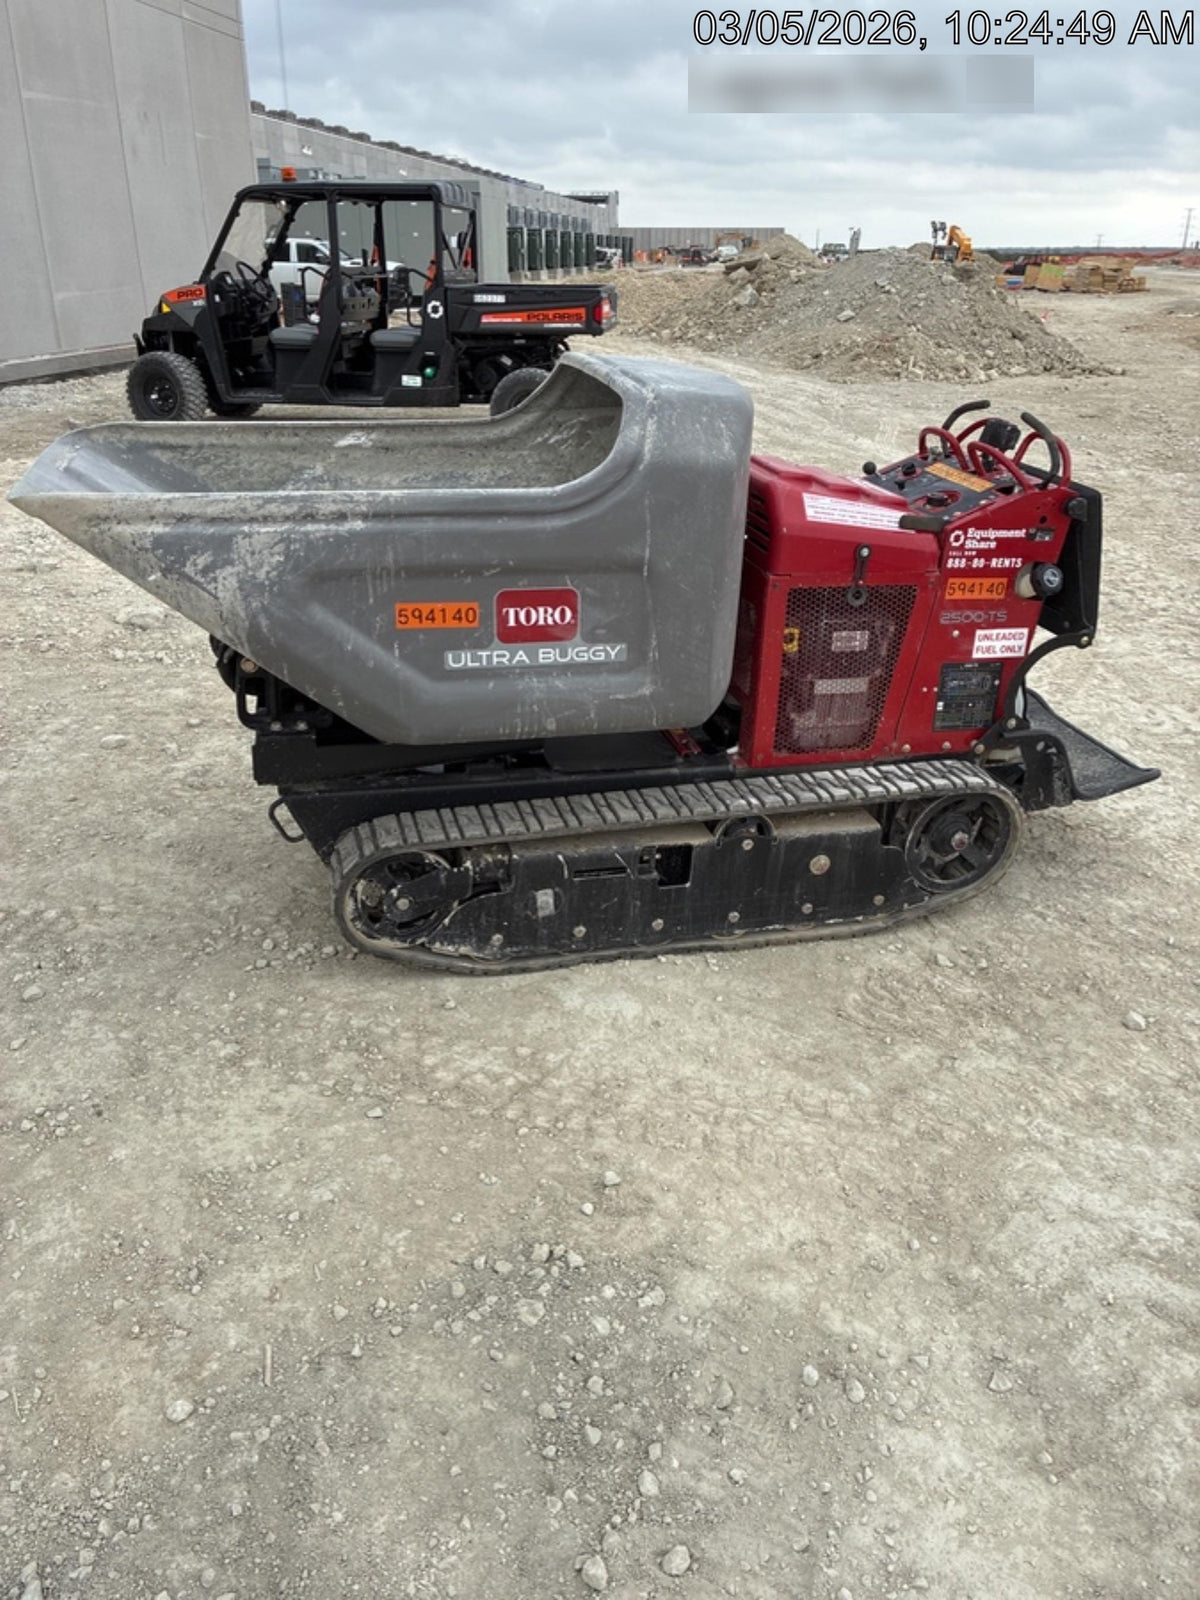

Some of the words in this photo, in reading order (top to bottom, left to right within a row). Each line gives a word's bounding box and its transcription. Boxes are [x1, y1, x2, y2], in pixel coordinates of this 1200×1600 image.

[177, 288, 204, 299] PRO
[526, 312, 584, 321] POLARIS
[967, 527, 1027, 540] Equipment
[964, 538, 997, 549] Share
[947, 580, 1006, 597] 594140
[397, 606, 478, 626] 594140
[502, 605, 573, 627] TORO
[978, 631, 1025, 642] UNLEADED
[976, 644, 998, 655] FUEL
[1000, 644, 1025, 654] ONLY
[447, 650, 531, 668] ULTRA
[538, 645, 622, 664] BUGGY
